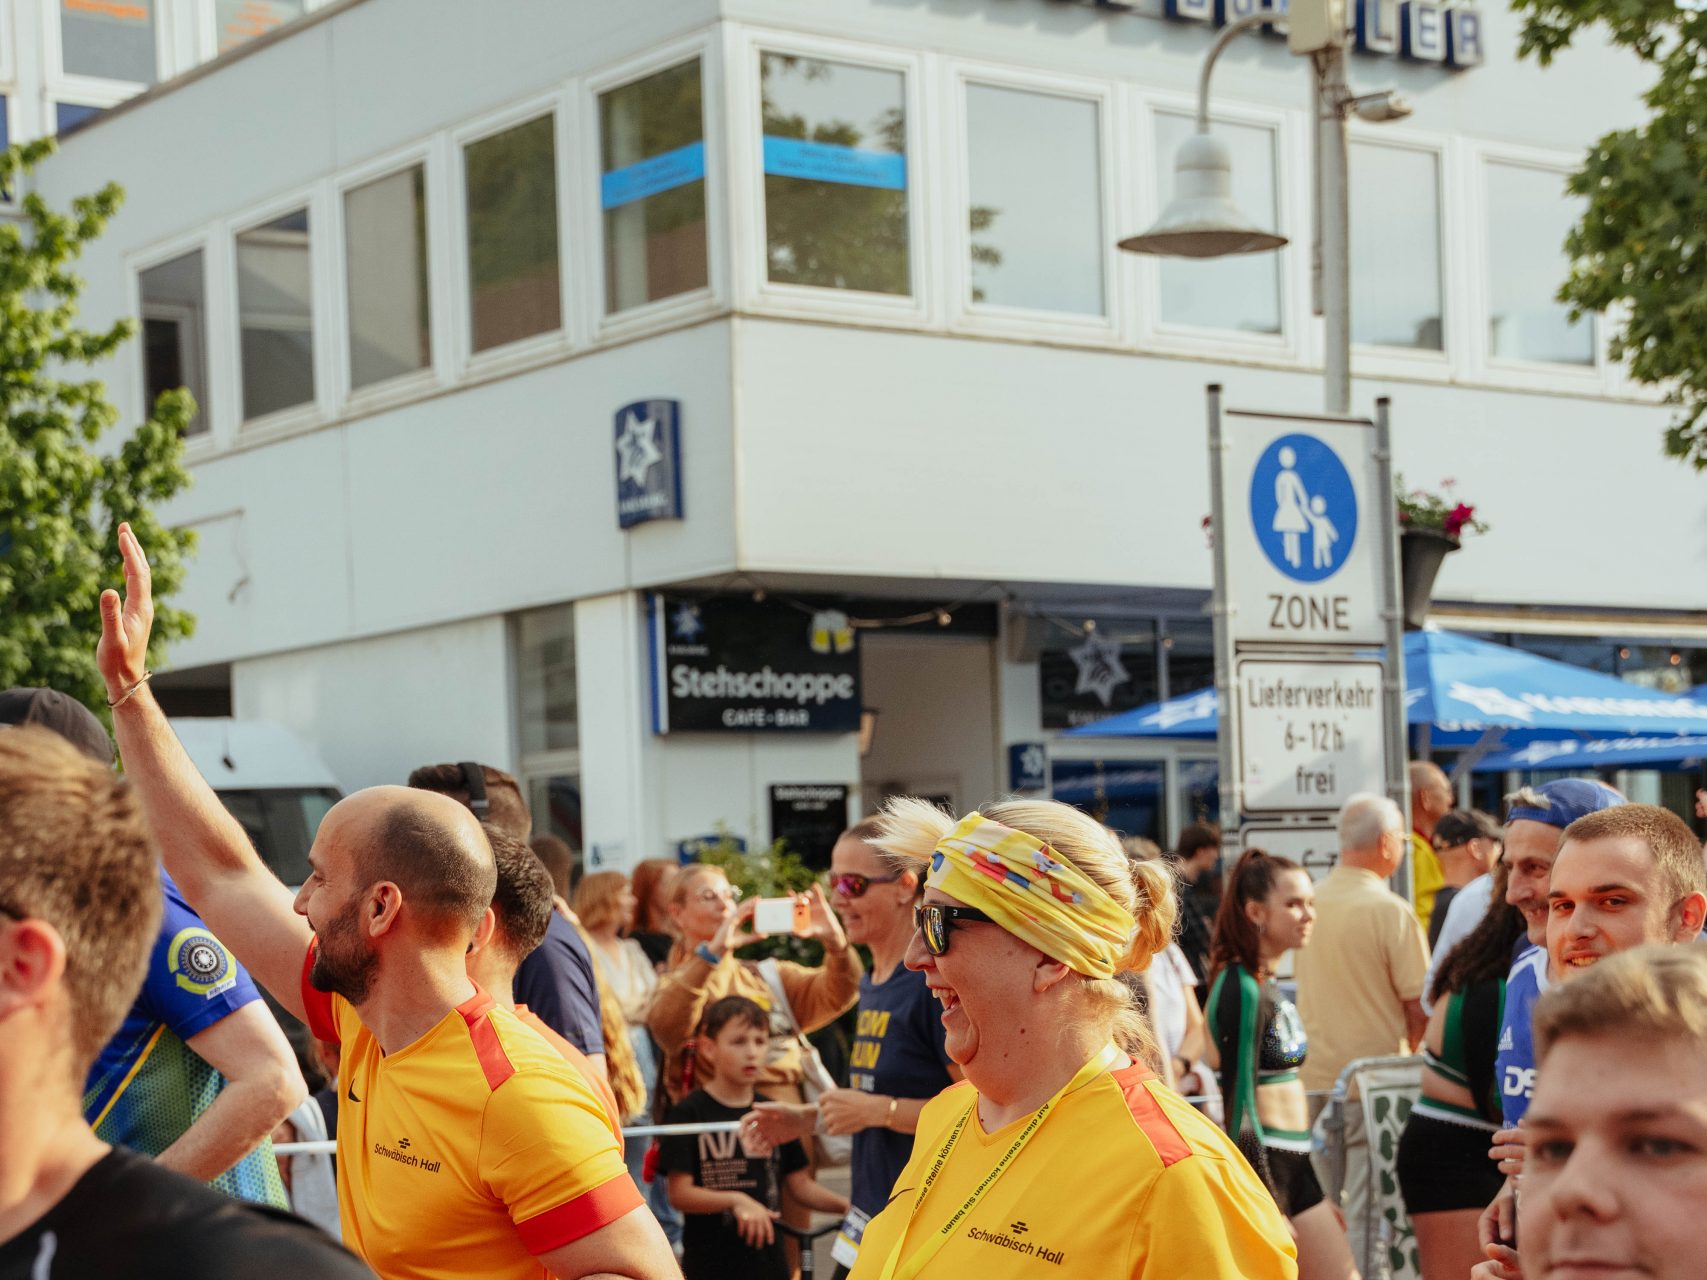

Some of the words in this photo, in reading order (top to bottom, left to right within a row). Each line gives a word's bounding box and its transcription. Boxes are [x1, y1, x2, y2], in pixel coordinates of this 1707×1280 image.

[1268, 595, 1350, 631] ZONE
[672, 664, 854, 704] Stehschoppe
[1248, 679, 1375, 708] Lieferverkehr
[1296, 765, 1335, 795] frei
[1038, 1103, 1049, 1119] Auf
[1020, 1118, 1038, 1141] diese
[420, 1159, 441, 1173] Hall
[925, 1159, 943, 1187] Steine
[938, 1128, 959, 1159] können
[1000, 1141, 1021, 1167] Steine
[974, 1167, 1001, 1196] können
[964, 1196, 976, 1210] Sie
[941, 1210, 966, 1235] bauen
[968, 1227, 1034, 1255] Schwäbisch
[1036, 1246, 1064, 1265] Hall
